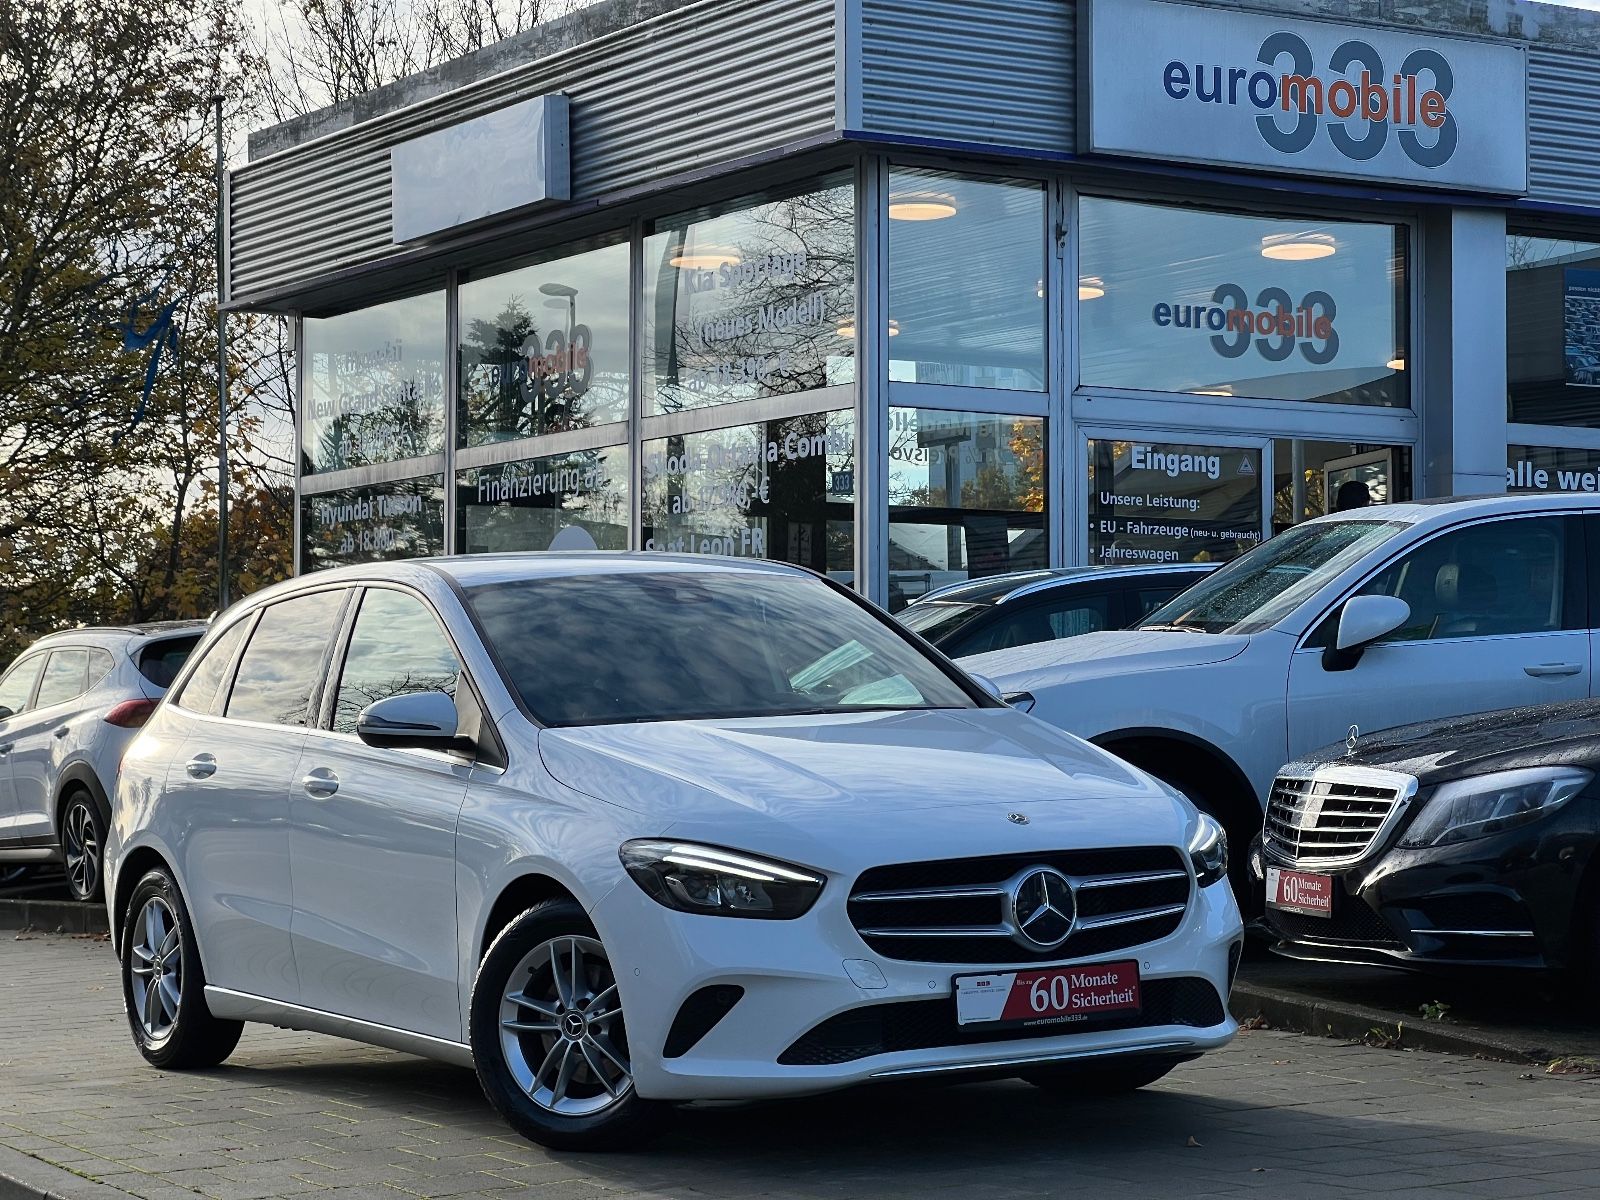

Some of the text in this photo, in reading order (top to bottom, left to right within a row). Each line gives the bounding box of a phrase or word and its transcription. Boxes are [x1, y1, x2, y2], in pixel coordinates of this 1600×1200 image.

[1163, 60, 1447, 128] euromobile
[1255, 31, 1458, 168] 333
[684, 253, 808, 294] Kia Sportage
[1153, 302, 1332, 339] euromobile
[308, 398, 337, 420] New
[785, 425, 853, 460] Combi
[1131, 446, 1220, 480] Eingang
[478, 465, 580, 503] Finanzierung
[321, 494, 421, 530] Hyundai Tucson
[1100, 491, 1201, 512] Unsere Leistung:
[741, 527, 764, 558] FR
[1100, 520, 1116, 533] EU
[1127, 522, 1189, 539] Fahrzeuge
[1220, 530, 1261, 541] gebraucht)
[1099, 545, 1179, 563] Jahreswagen
[1284, 876, 1322, 902] 60 Monate
[1030, 972, 1118, 1012] 60 Monate
[1023, 1014, 1089, 1026] www.euromobile333.de
